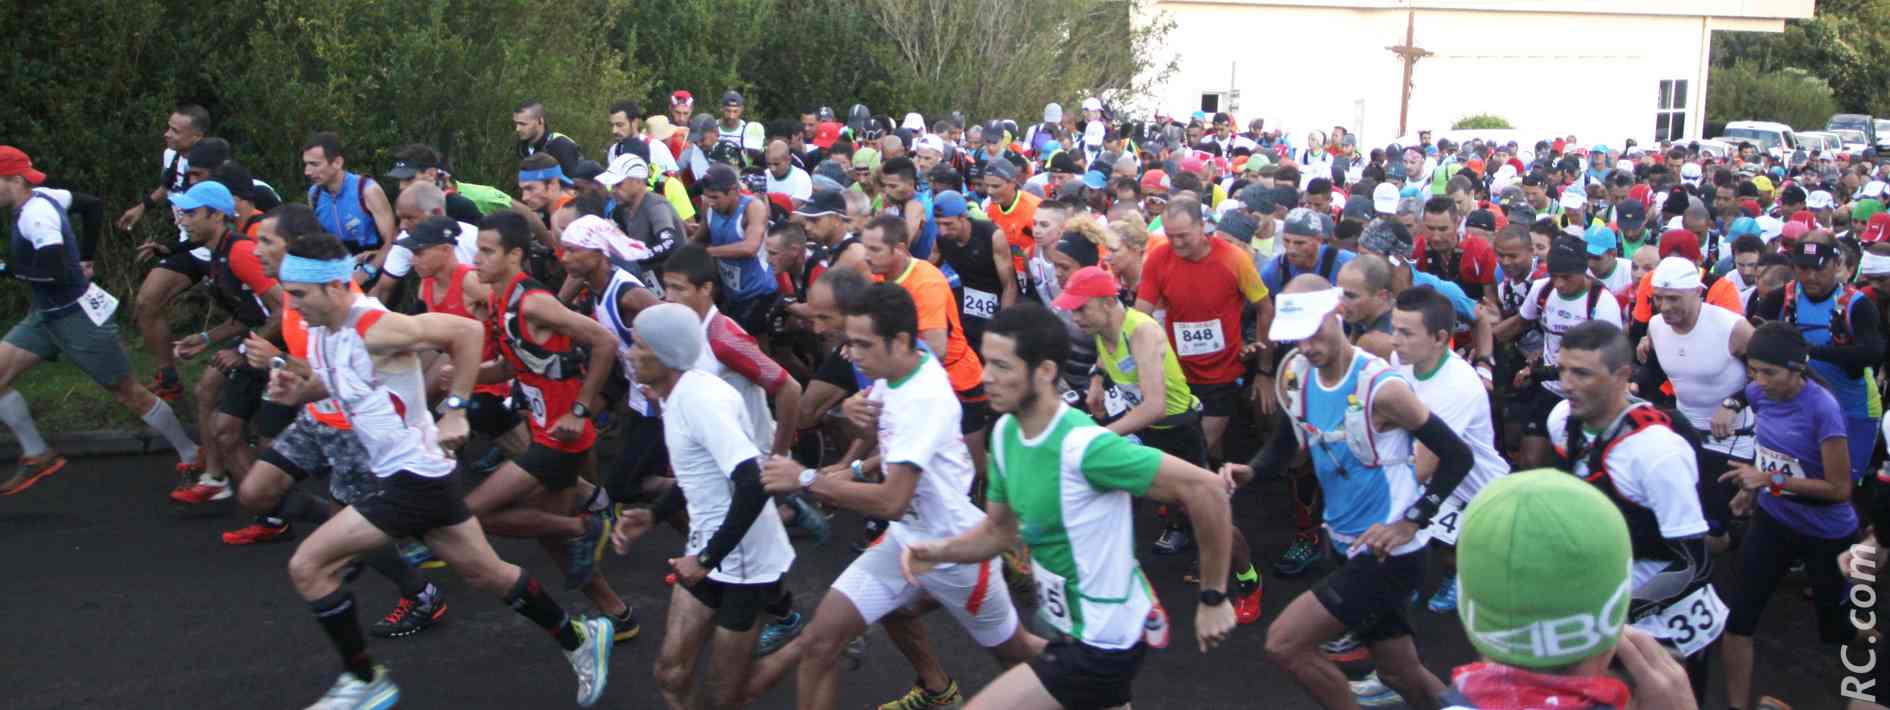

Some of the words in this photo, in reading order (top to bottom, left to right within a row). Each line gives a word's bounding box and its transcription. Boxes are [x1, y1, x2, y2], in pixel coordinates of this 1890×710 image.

[965, 295, 996, 314] 248
[1182, 328, 1215, 343] 848
[1667, 598, 1713, 644] 33
